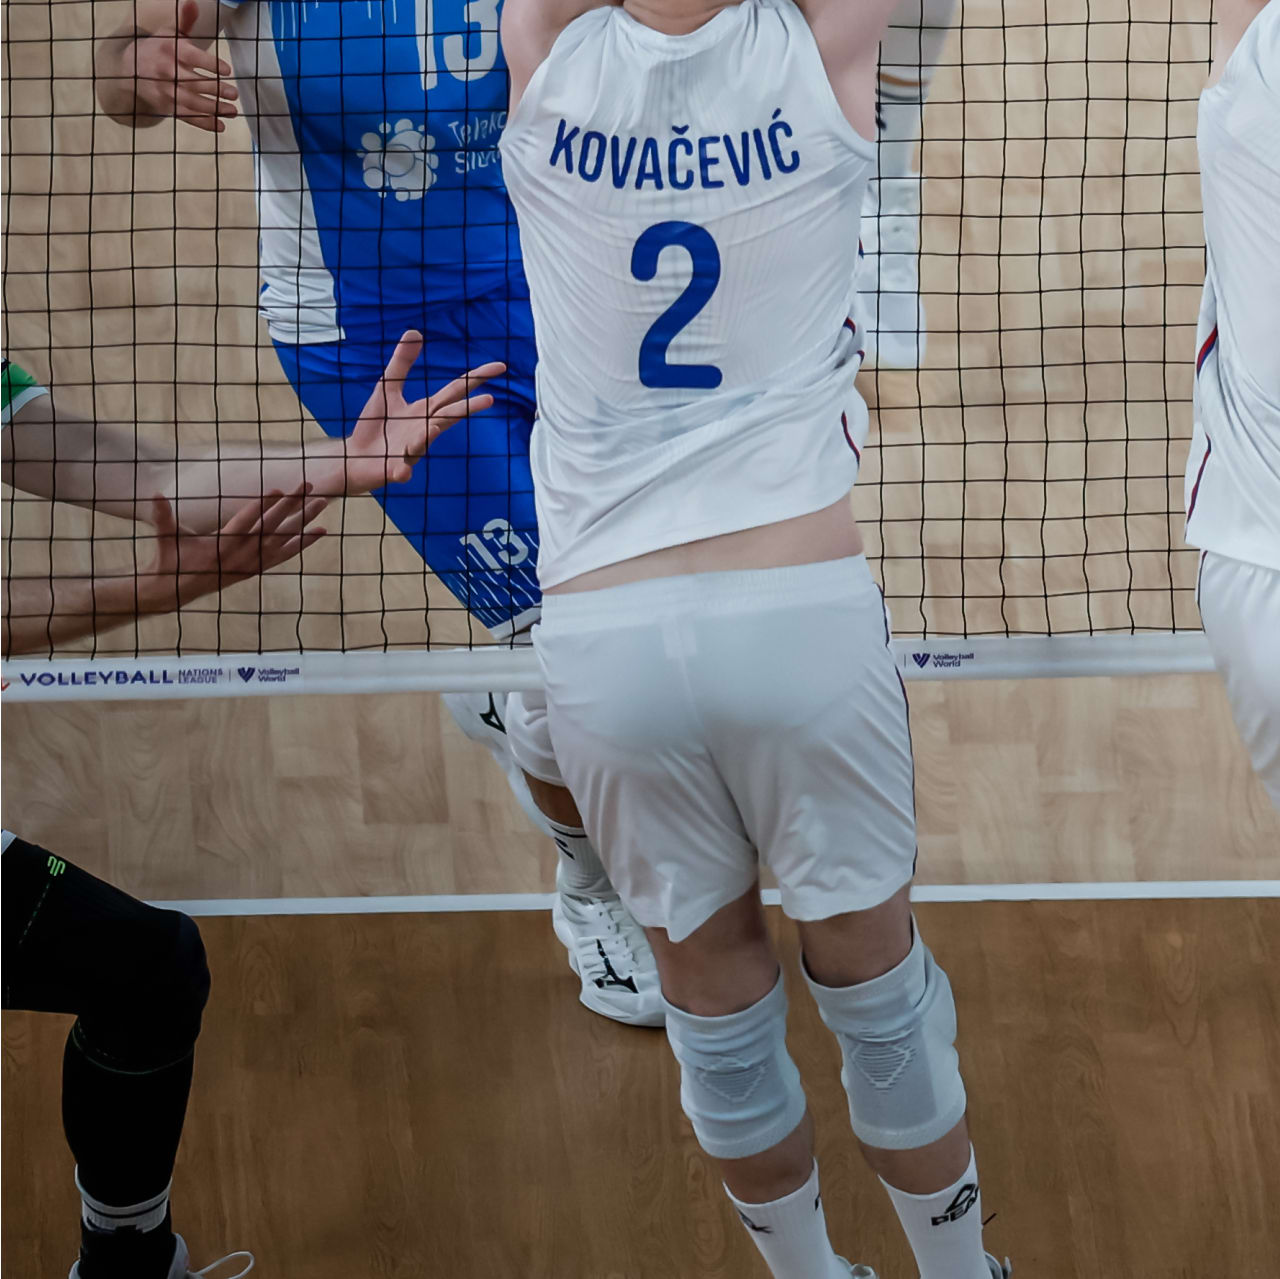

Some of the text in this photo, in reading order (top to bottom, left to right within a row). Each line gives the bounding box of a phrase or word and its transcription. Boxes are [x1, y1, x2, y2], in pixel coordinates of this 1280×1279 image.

[550, 107, 800, 190] KOVAČEVIĆ
[631, 220, 723, 389] 2
[459, 518, 529, 575] 13
[932, 652, 975, 662] Volleyball
[932, 659, 961, 668] World
[20, 669, 173, 687] VOLLEYBALL
[178, 668, 223, 677] NATIONS
[257, 667, 300, 678] Volleyball
[178, 674, 286, 684] LEAGUE World
